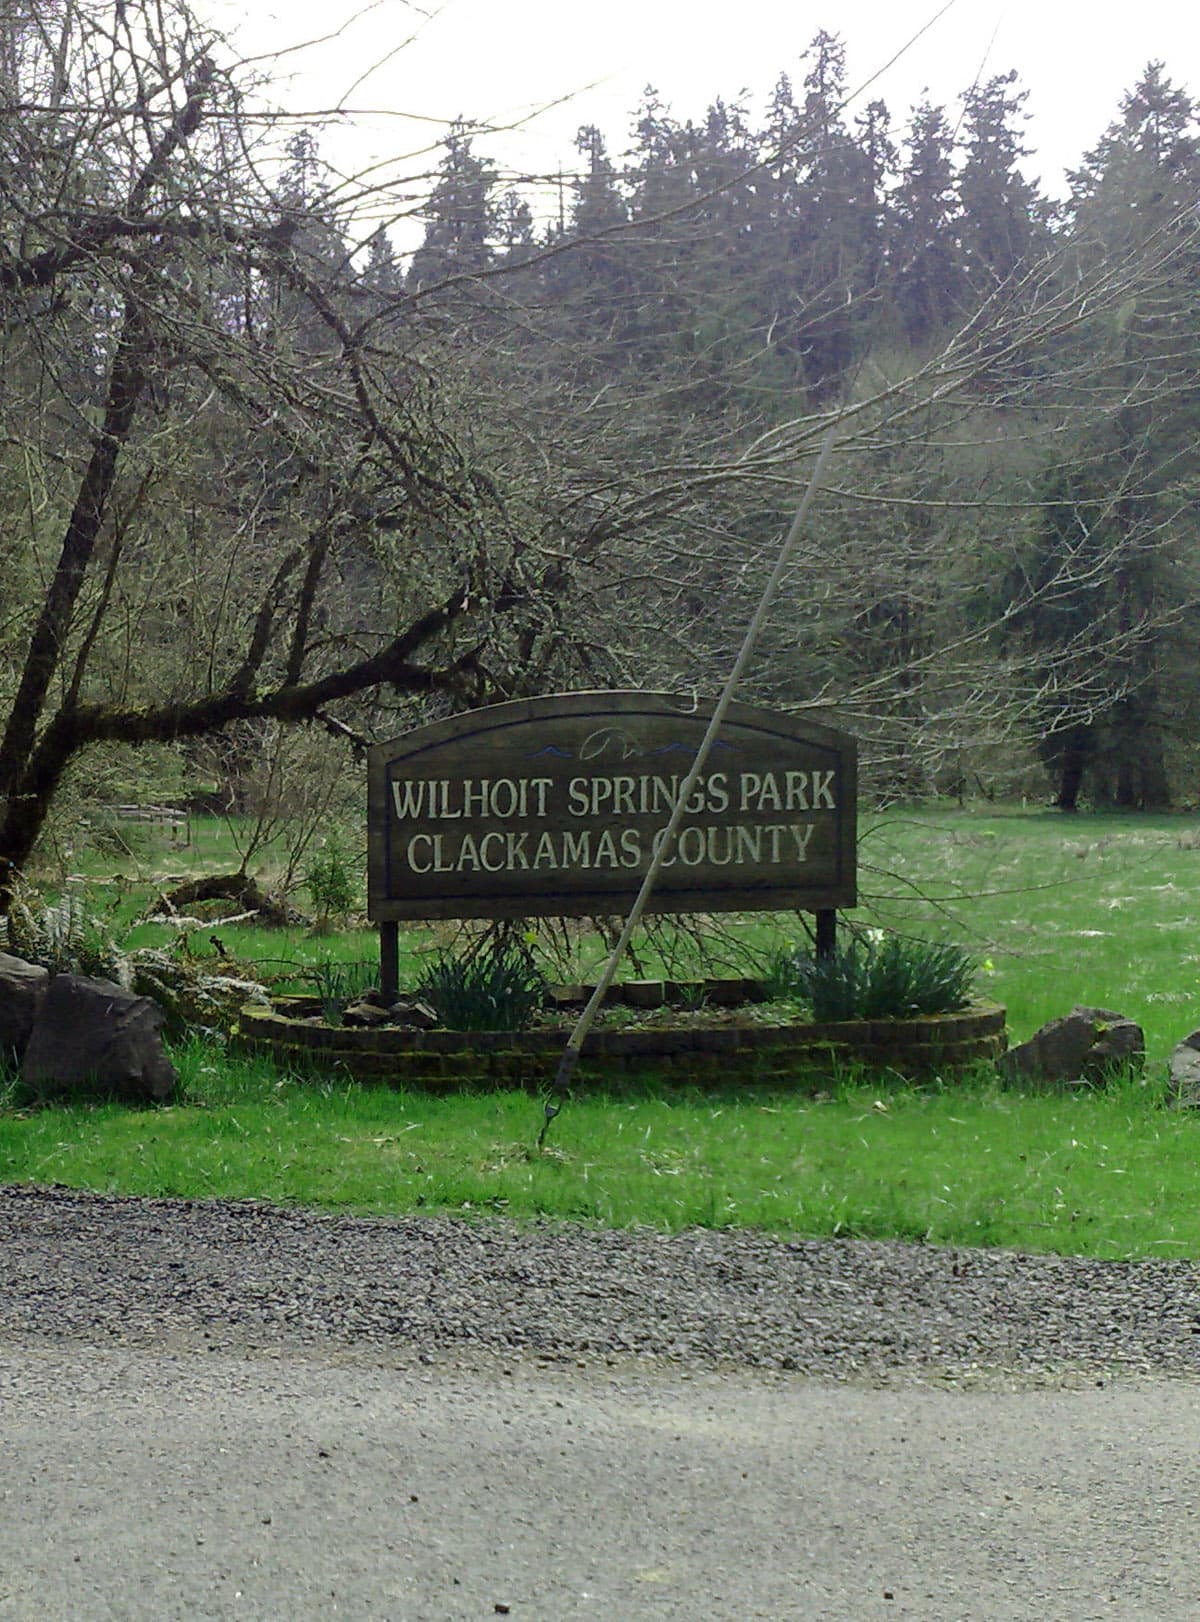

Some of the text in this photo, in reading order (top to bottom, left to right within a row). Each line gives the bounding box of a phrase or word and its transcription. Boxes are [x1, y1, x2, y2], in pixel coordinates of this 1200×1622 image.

[392, 770, 836, 819] WILHOIT SPRINGS PARK
[407, 824, 814, 873] CLACKAMAS COUNTY
